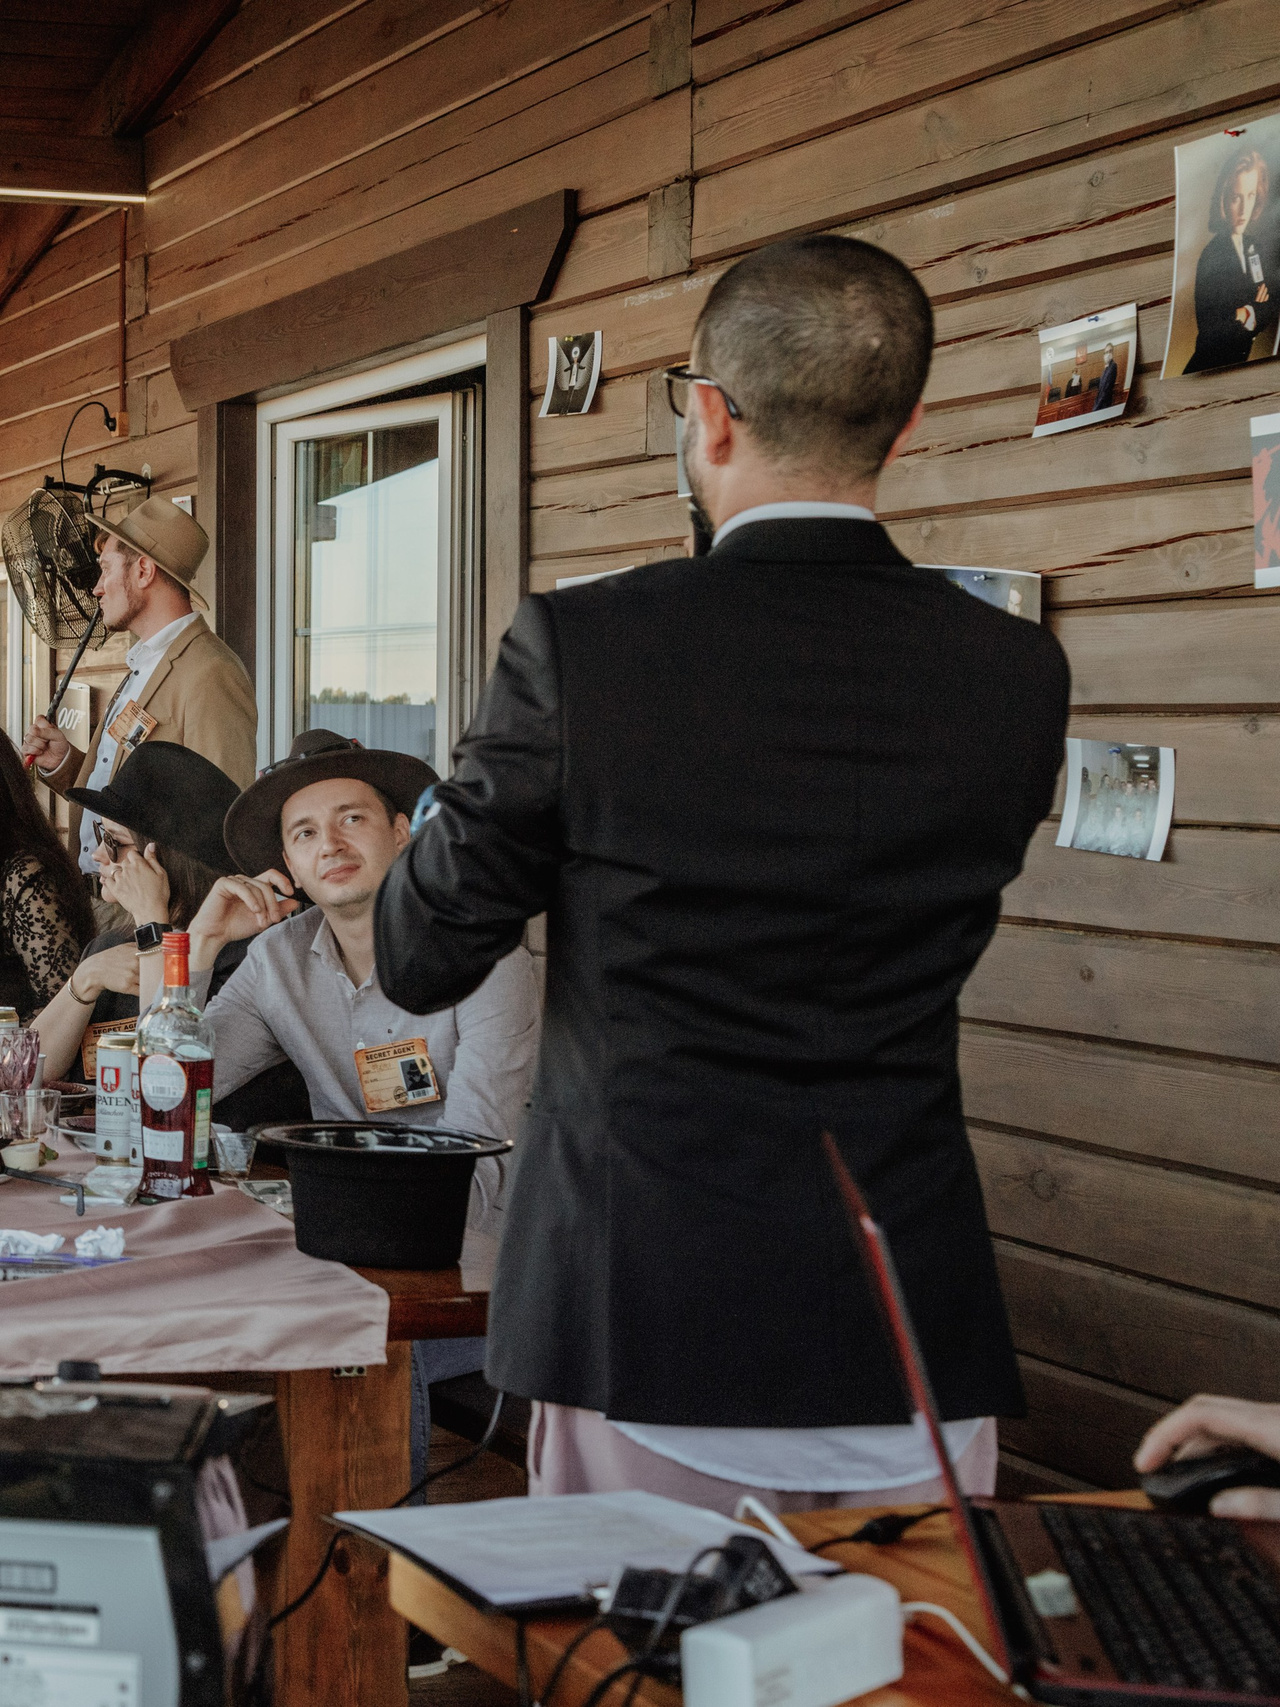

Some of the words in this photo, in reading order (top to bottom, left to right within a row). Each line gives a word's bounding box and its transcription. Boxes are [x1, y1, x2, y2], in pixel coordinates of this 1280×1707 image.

[123, 1022, 138, 1031] AGE
[365, 1051, 391, 1061] SECRET
[393, 1045, 416, 1055] AGENT
